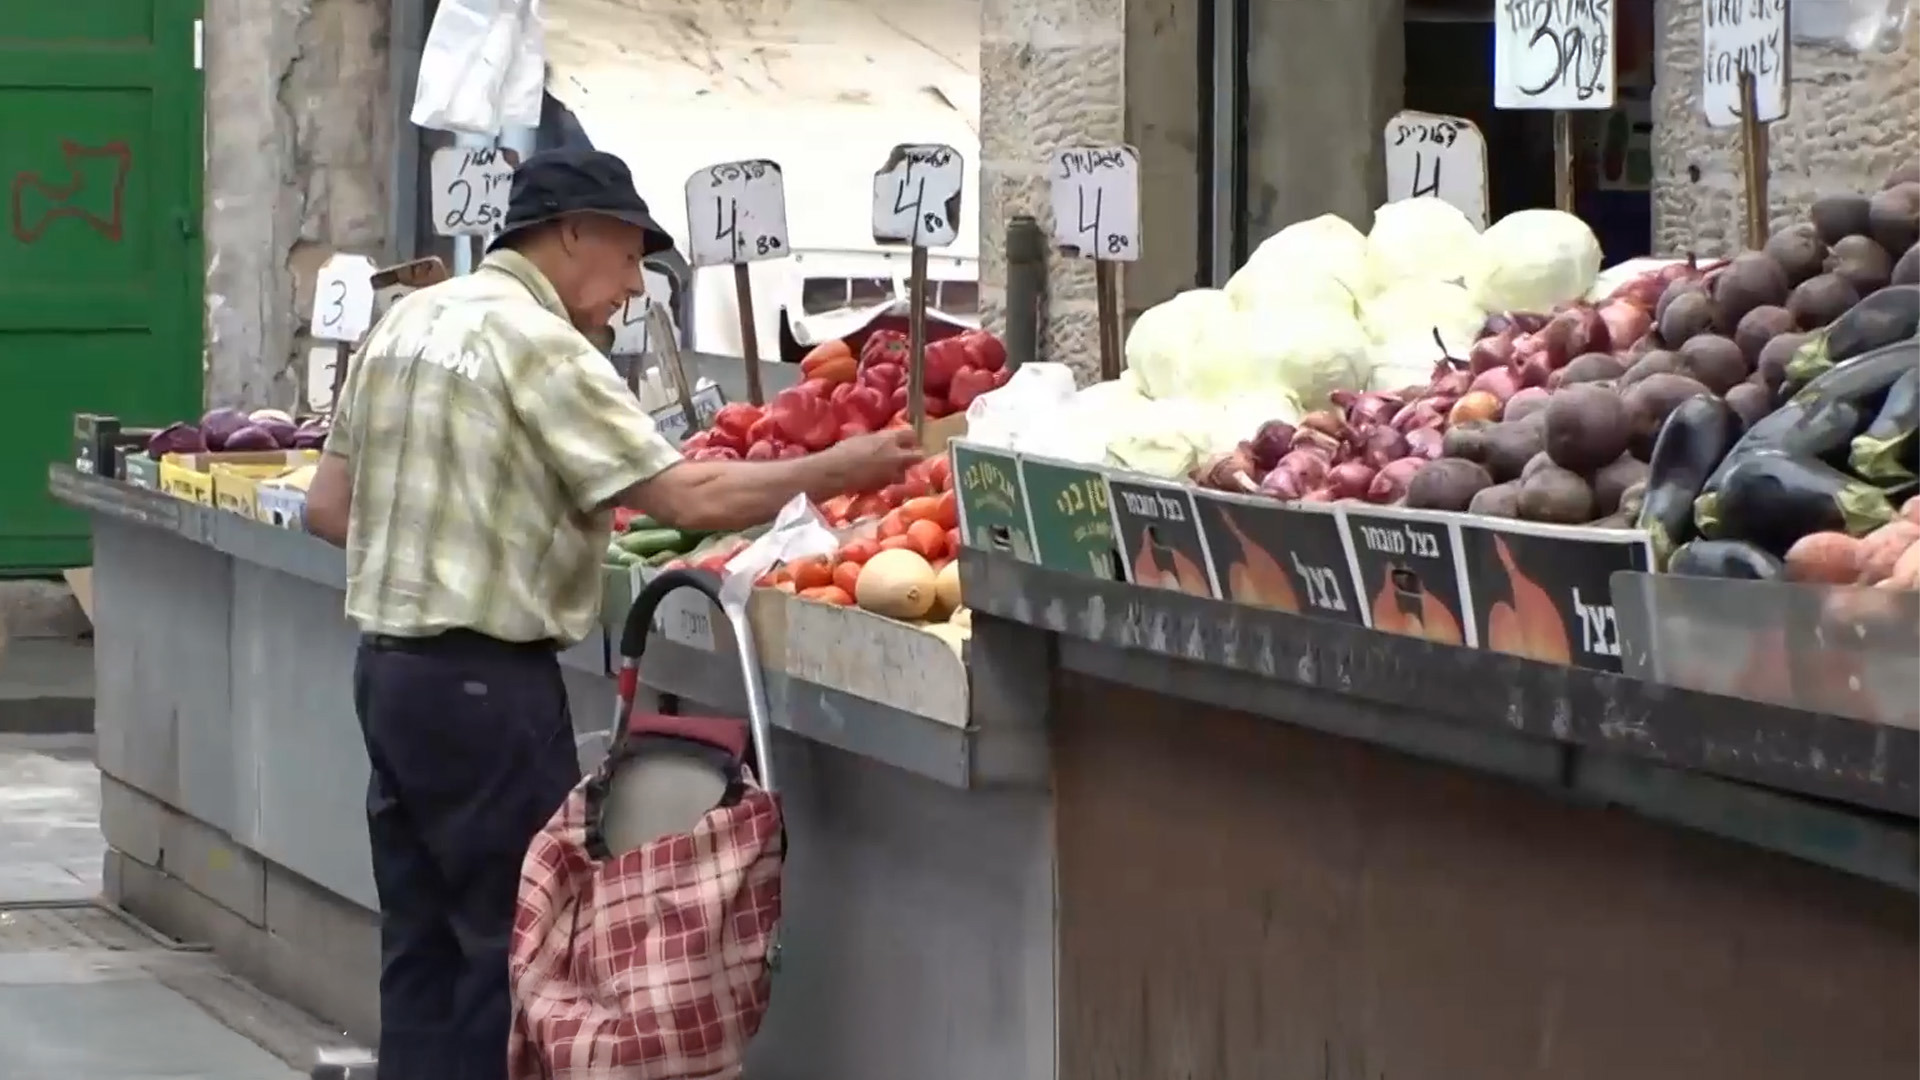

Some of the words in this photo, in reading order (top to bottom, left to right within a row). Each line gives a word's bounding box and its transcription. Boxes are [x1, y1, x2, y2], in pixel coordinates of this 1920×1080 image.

[1413, 151, 1440, 198] 4
[445, 179, 475, 227] 2
[894, 177, 925, 243] 4
[924, 212, 943, 233] 80
[1079, 185, 1102, 260] 4
[1107, 235, 1128, 254] 80
[715, 196, 736, 260] 4
[756, 235, 781, 255] 80
[323, 280, 347, 326] 3
[1156, 491, 1186, 522] בצל
[1360, 525, 1405, 554] מובחר
[1404, 523, 1440, 558] בצל
[1290, 550, 1348, 612] בצל
[1572, 586, 1622, 657] בצל
